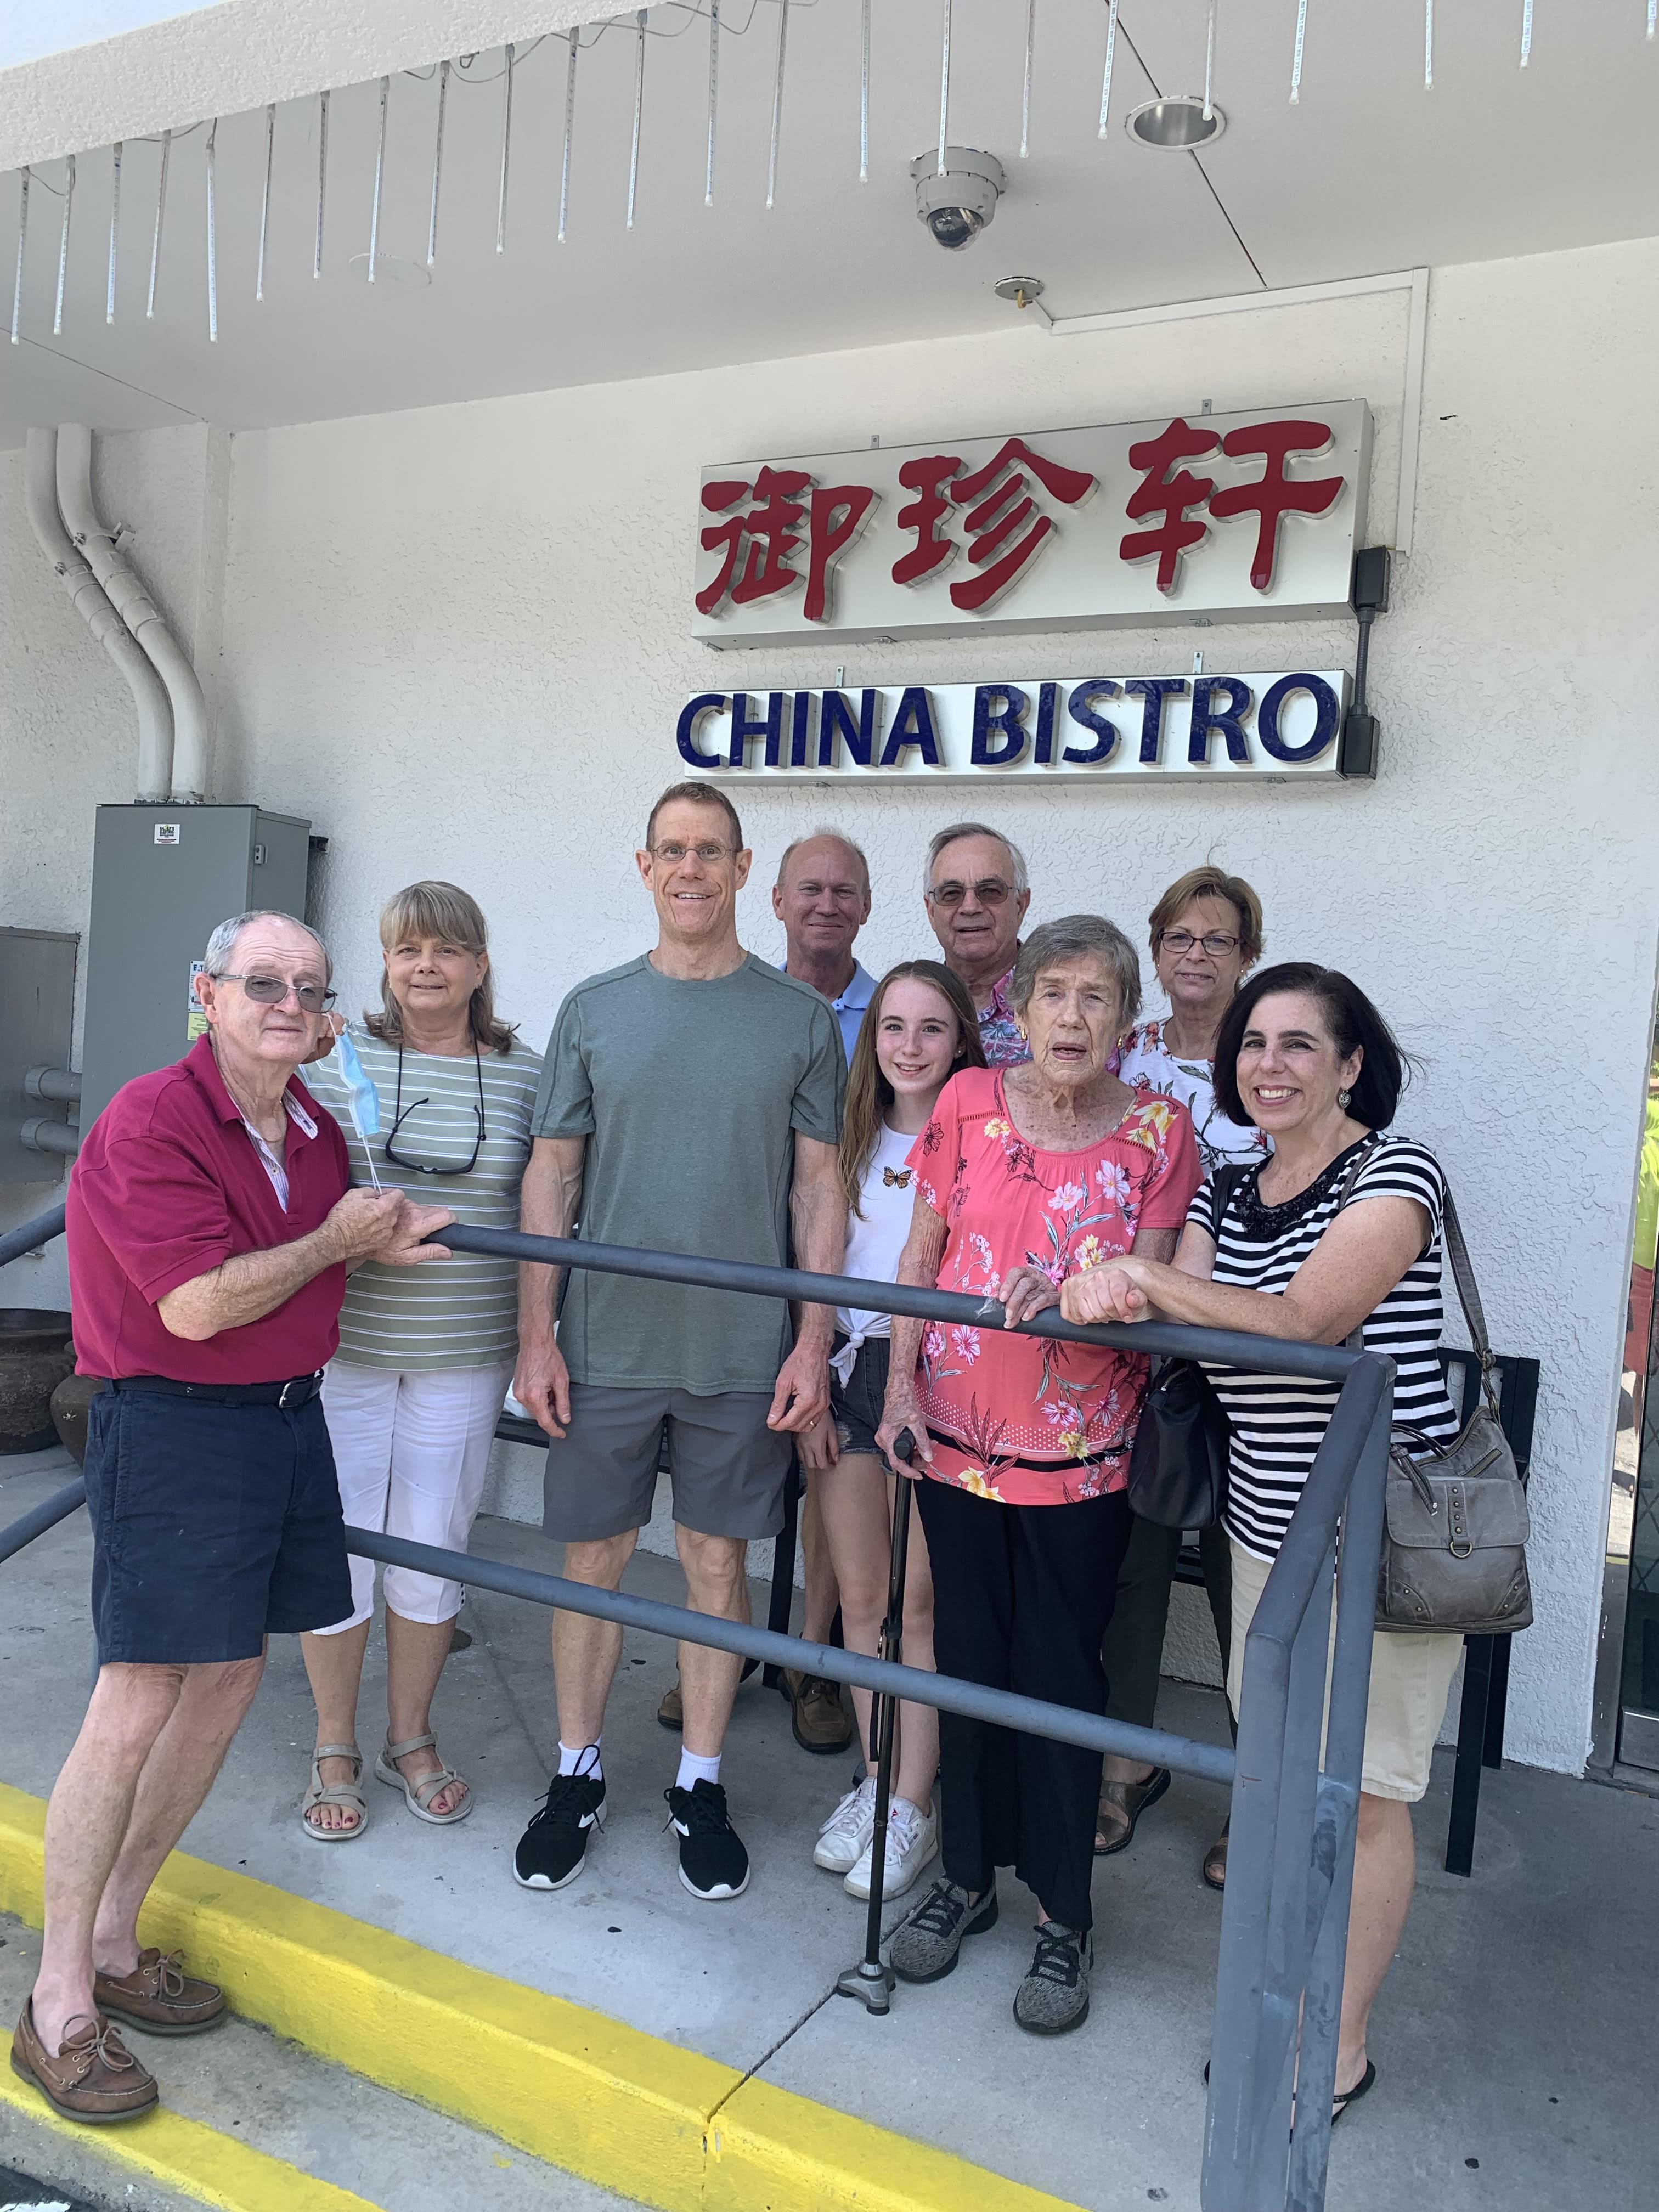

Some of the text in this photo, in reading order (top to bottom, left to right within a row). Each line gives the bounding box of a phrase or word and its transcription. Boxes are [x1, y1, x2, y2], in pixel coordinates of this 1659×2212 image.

[696, 419, 1343, 620] 御珍轩
[676, 673, 1339, 768] CHINA BISTRO
